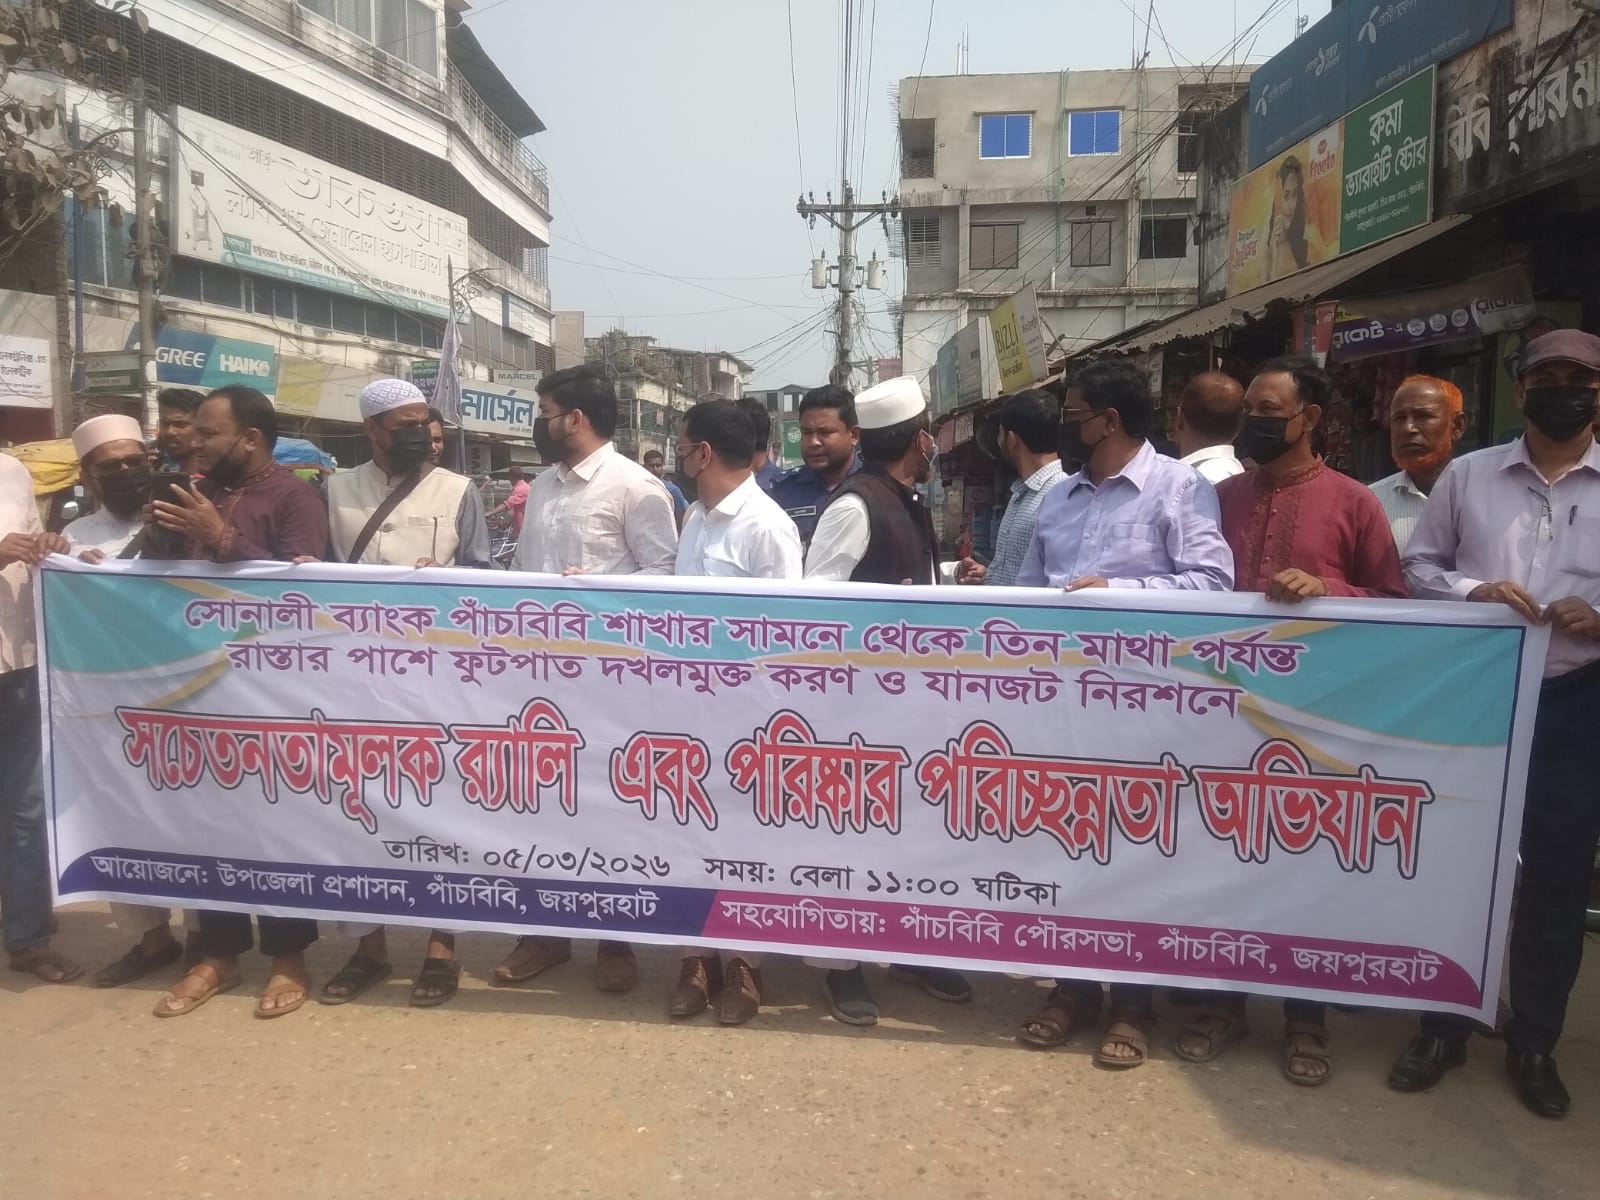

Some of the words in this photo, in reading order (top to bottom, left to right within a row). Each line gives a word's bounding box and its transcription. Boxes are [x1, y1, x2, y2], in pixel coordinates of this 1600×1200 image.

[1369, 99, 1404, 146] রুমা
[1345, 145, 1393, 197] ভ্যারাইটি
[155, 346, 206, 369] GREE
[220, 353, 270, 377] HAIKO
[498, 373, 537, 381] MARCEL
[461, 388, 535, 427] মার্সেল
[185, 593, 317, 631] সোনালী
[329, 601, 438, 636] ব্যাংক
[450, 598, 592, 640] পাঁচবিবি
[602, 610, 715, 647] শাখার
[726, 614, 849, 651] সামনে
[863, 620, 968, 656] থেকে
[981, 619, 1065, 662] তিন
[1077, 631, 1176, 668] মাথা
[1192, 630, 1304, 673] পর্যন্ত
[223, 641, 332, 672] রাস্তার
[348, 644, 438, 675] পাশে
[450, 642, 588, 687] ফুটপাত
[597, 653, 756, 696] দখলমুক্ত
[765, 663, 860, 695] করণ
[875, 671, 905, 695] ও
[921, 665, 1064, 705] যানজট
[1075, 668, 1244, 718] নিরশনে
[115, 706, 450, 834] সচেতনতামূলক
[609, 731, 718, 831] এবং
[915, 719, 1193, 865] পরিচ্ছন্নতা
[1189, 737, 1436, 880] অভিযান
[90, 855, 209, 887] আয়োজনে:
[216, 859, 316, 896] উপজেলা
[323, 874, 416, 908] প্রশাসন,
[426, 873, 528, 916] পাঁচবিবি,
[536, 886, 661, 921] জয়পুরহাট
[382, 835, 469, 864] তারিখ:
[483, 844, 671, 879] ০৫/০৩/২০২৬
[702, 858, 775, 884] সময়:
[790, 865, 855, 891] বেলা
[866, 870, 960, 896] ১১:০০
[972, 871, 1062, 907] ঘটিকা
[720, 898, 886, 935] সহযোগিতায়:
[900, 906, 1004, 945] পাঁচবিবি
[1014, 916, 1144, 963] পৌরসভা,
[1158, 928, 1279, 975] পাঁচবিবি,
[1292, 946, 1443, 986] জয়পুরহাট
